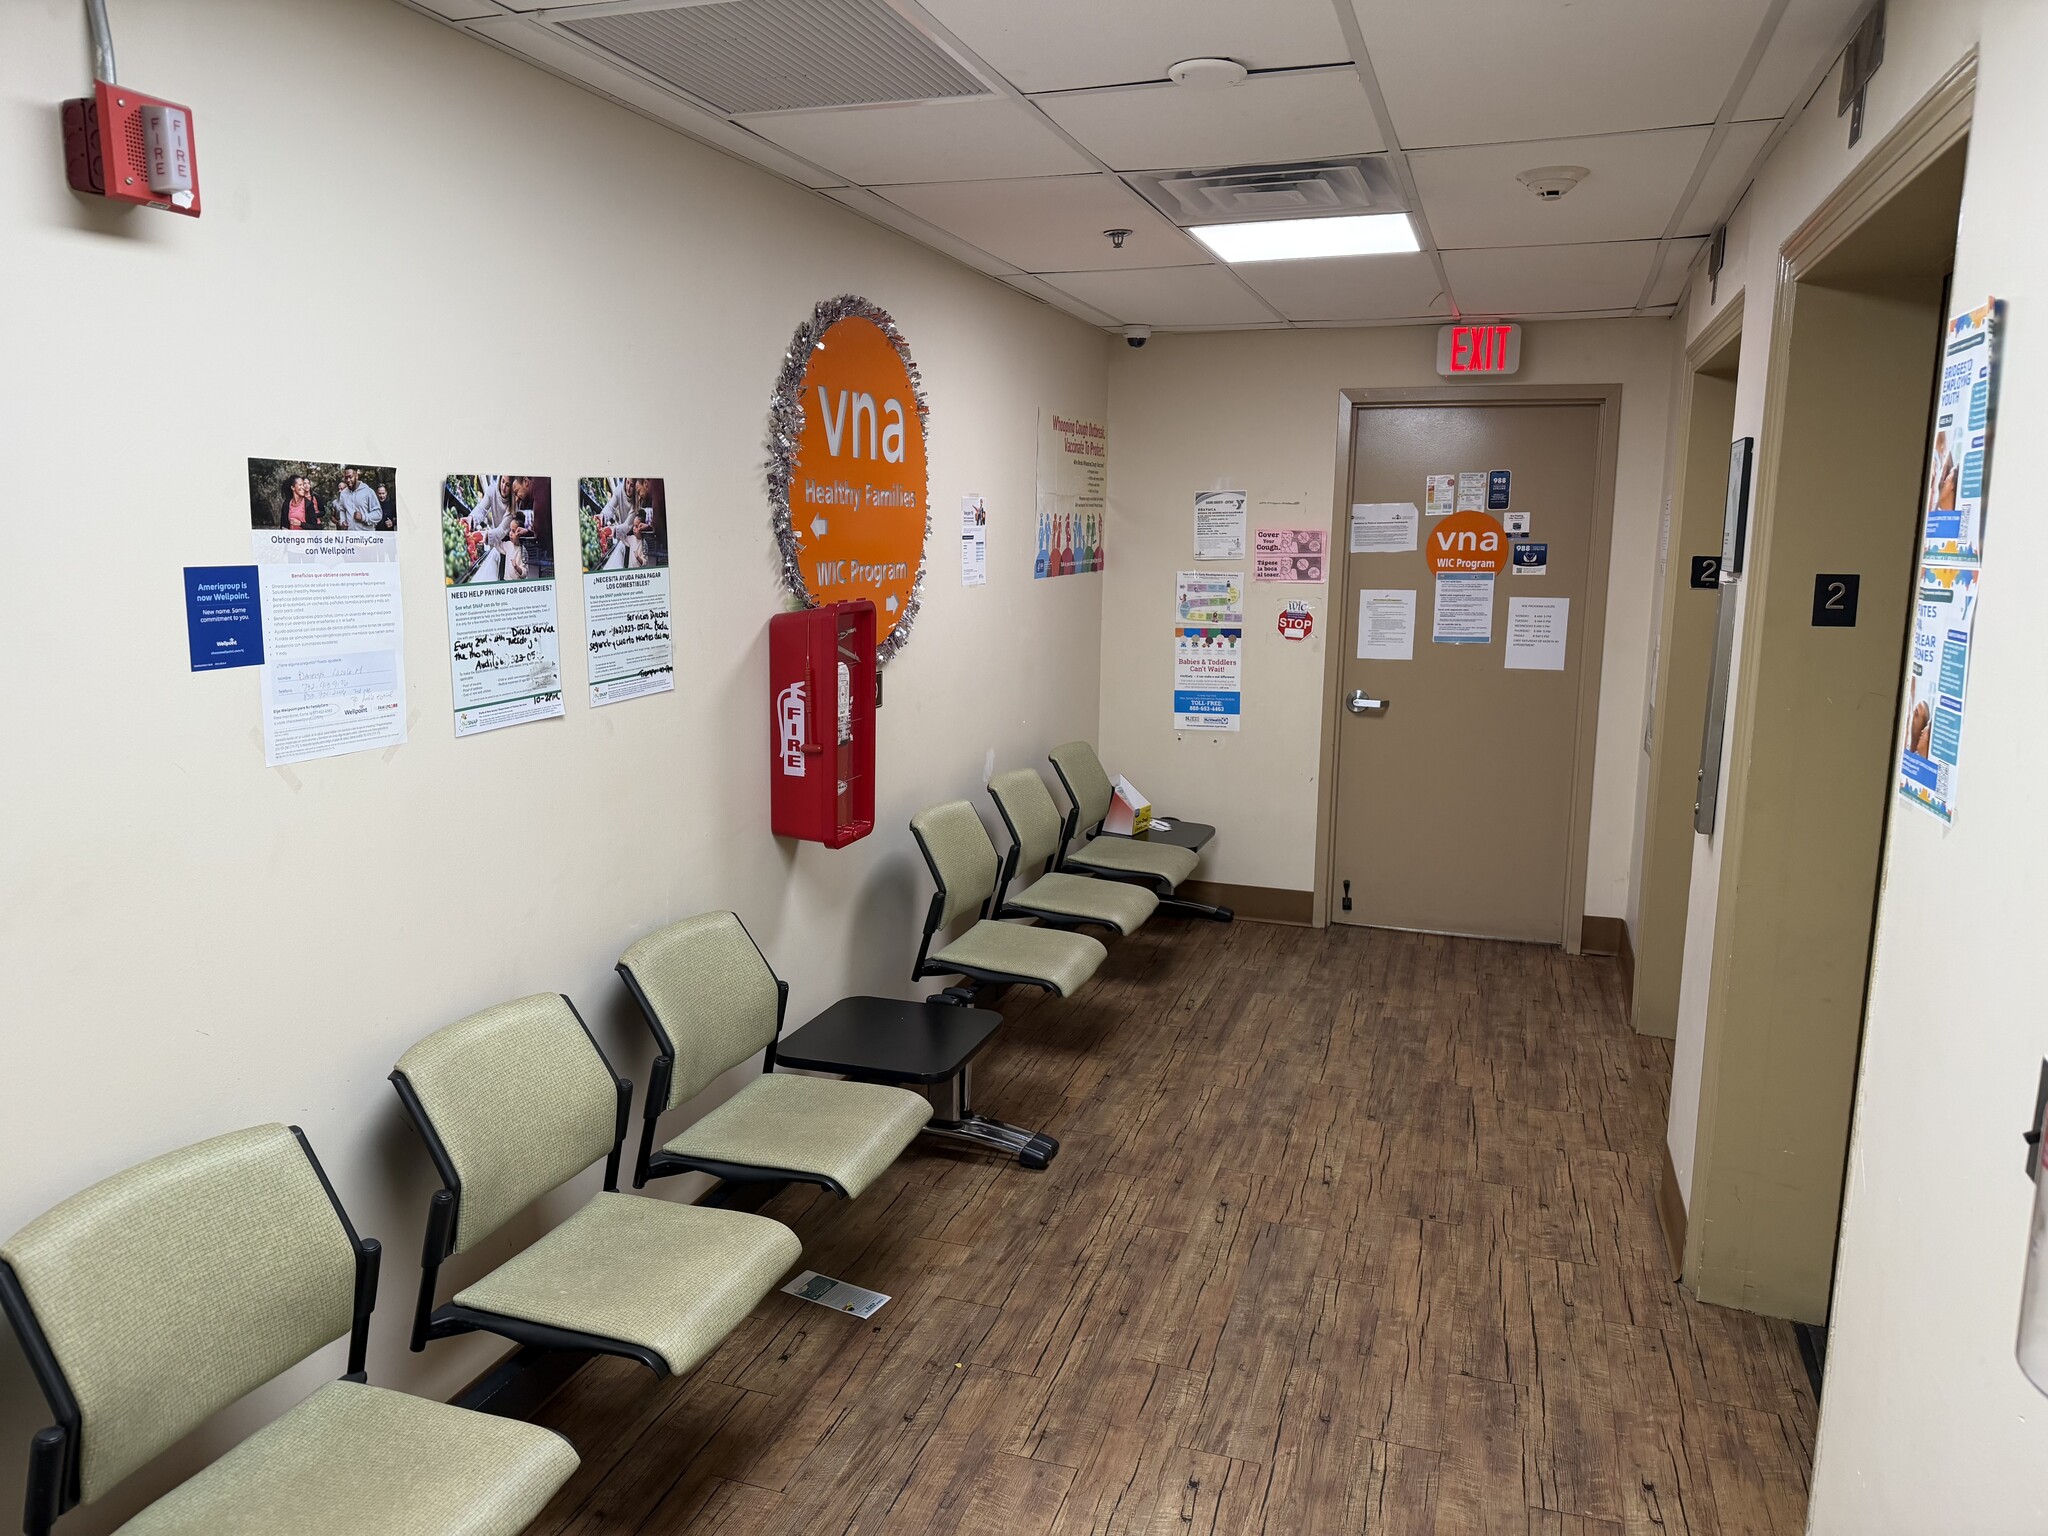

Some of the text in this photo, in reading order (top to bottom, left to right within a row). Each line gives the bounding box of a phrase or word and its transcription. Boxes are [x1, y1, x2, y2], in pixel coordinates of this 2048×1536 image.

[150, 117, 165, 175] FIRE
[172, 120, 187, 178] FIRE
[1450, 326, 1512, 372] EXIT
[1942, 391, 1960, 406] YOUTH
[817, 385, 905, 464] vna
[1053, 414, 1075, 436] Whooping
[1076, 420, 1089, 439] Cough
[1064, 438, 1085, 455] Vaccinate
[1085, 441, 1090, 455] To
[805, 479, 917, 511] Healthy Families
[271, 536, 306, 545] Obtenga
[307, 535, 323, 543] más
[335, 536, 344, 544] NJ
[346, 536, 384, 546] FamilyCare
[1436, 531, 1499, 551] vna
[320, 547, 355, 556] Wellpoint
[1437, 558, 1495, 570] WIC Program
[1701, 560, 1717, 582] 2
[593, 575, 619, 585] ¿NECESITA
[816, 559, 908, 588] WIC Program
[198, 583, 241, 592] Amerigroup
[469, 590, 484, 598] HELP
[485, 588, 506, 597] PAYING
[519, 585, 552, 594] GROCERIES?
[616, 580, 650, 589] COMESTIBLES?
[214, 593, 250, 602] Wellpoint.
[1825, 582, 1846, 610] 2
[511, 626, 531, 637] Direct
[1280, 618, 1312, 629] STOP
[454, 641, 474, 652] Every
[475, 635, 488, 647] 2nd
[344, 707, 368, 716] Wellpoint
[788, 707, 801, 768] FIRE
